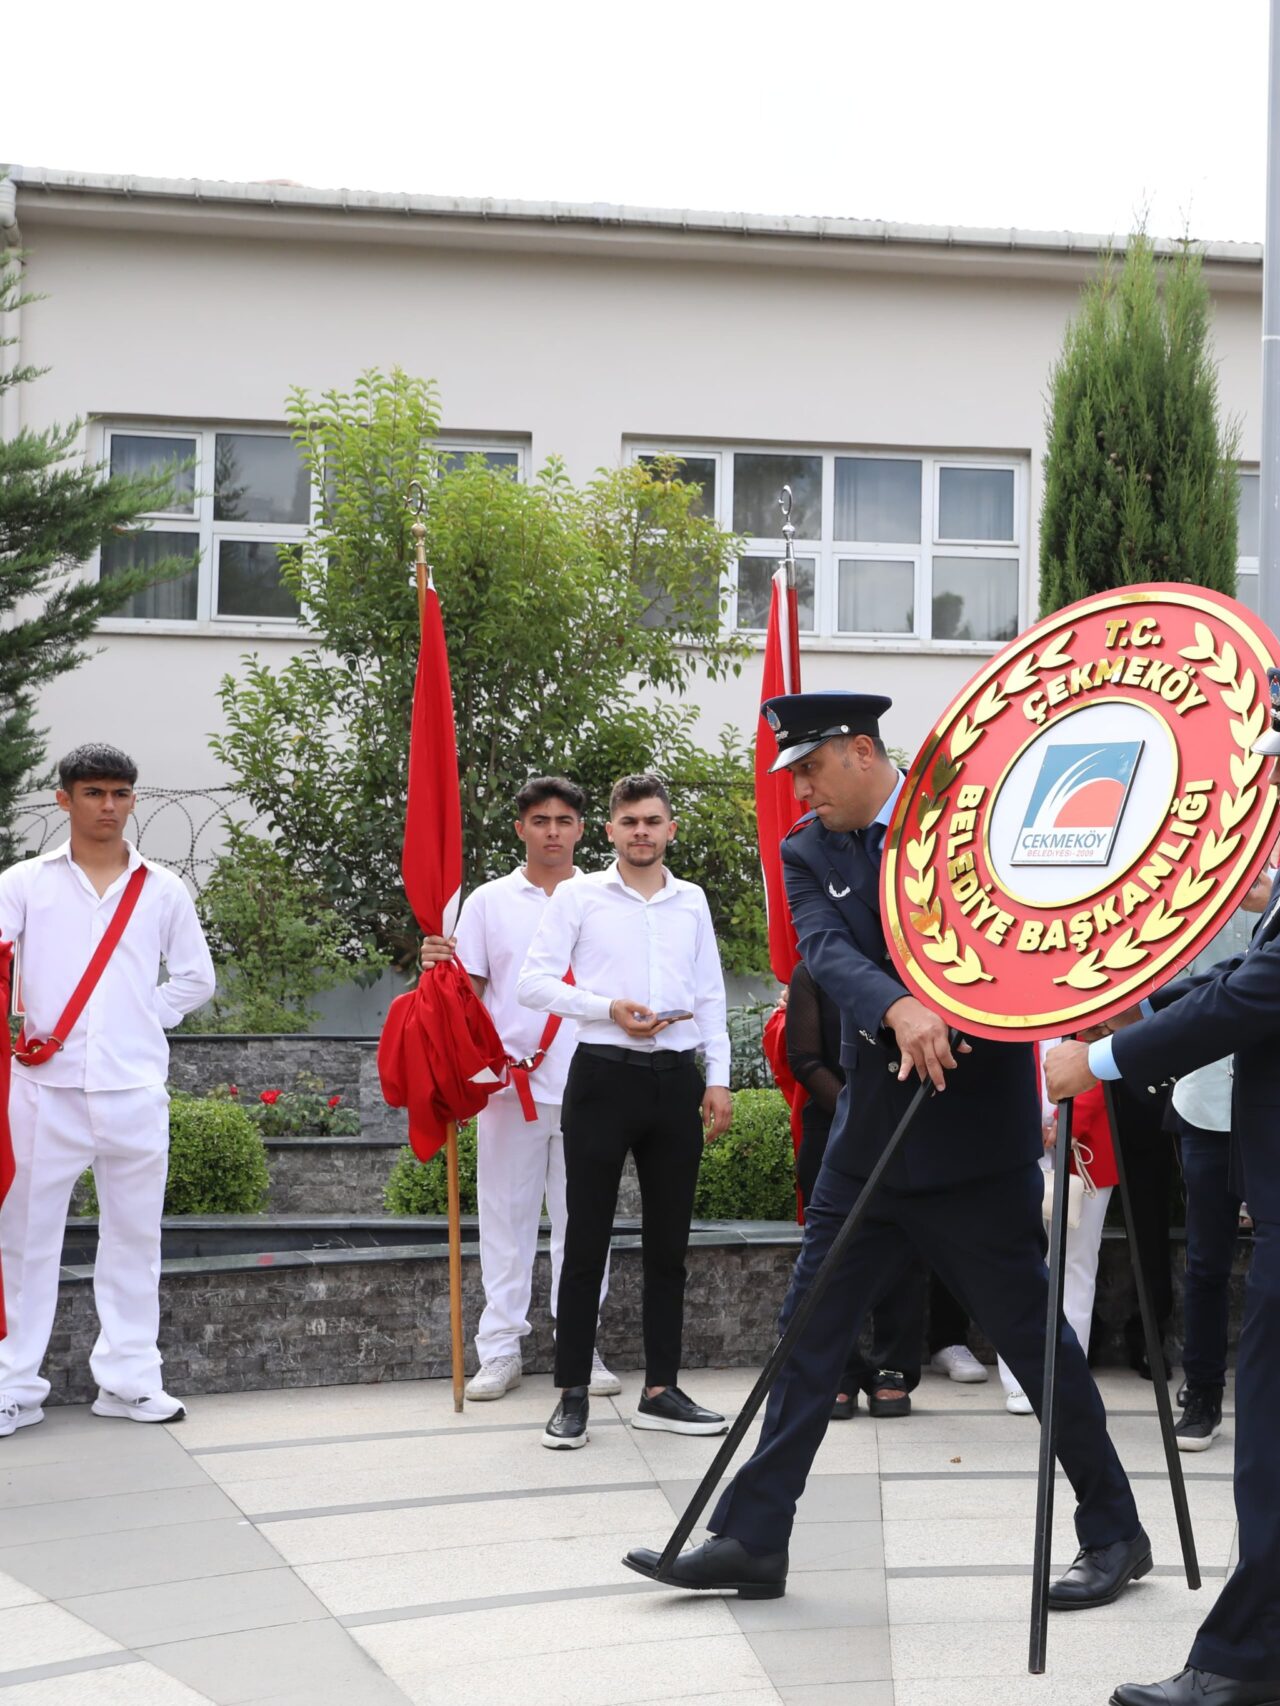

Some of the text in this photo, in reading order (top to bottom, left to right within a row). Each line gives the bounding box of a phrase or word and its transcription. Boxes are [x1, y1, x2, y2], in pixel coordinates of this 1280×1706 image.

[1105, 618, 1163, 648] T.C.
[1022, 656, 1208, 724] ÇEKMEKÖY
[1022, 829, 1107, 850] ÇEKMEKÖY
[947, 779, 1216, 953] BELEDİYE BAŞKANLIĞI
